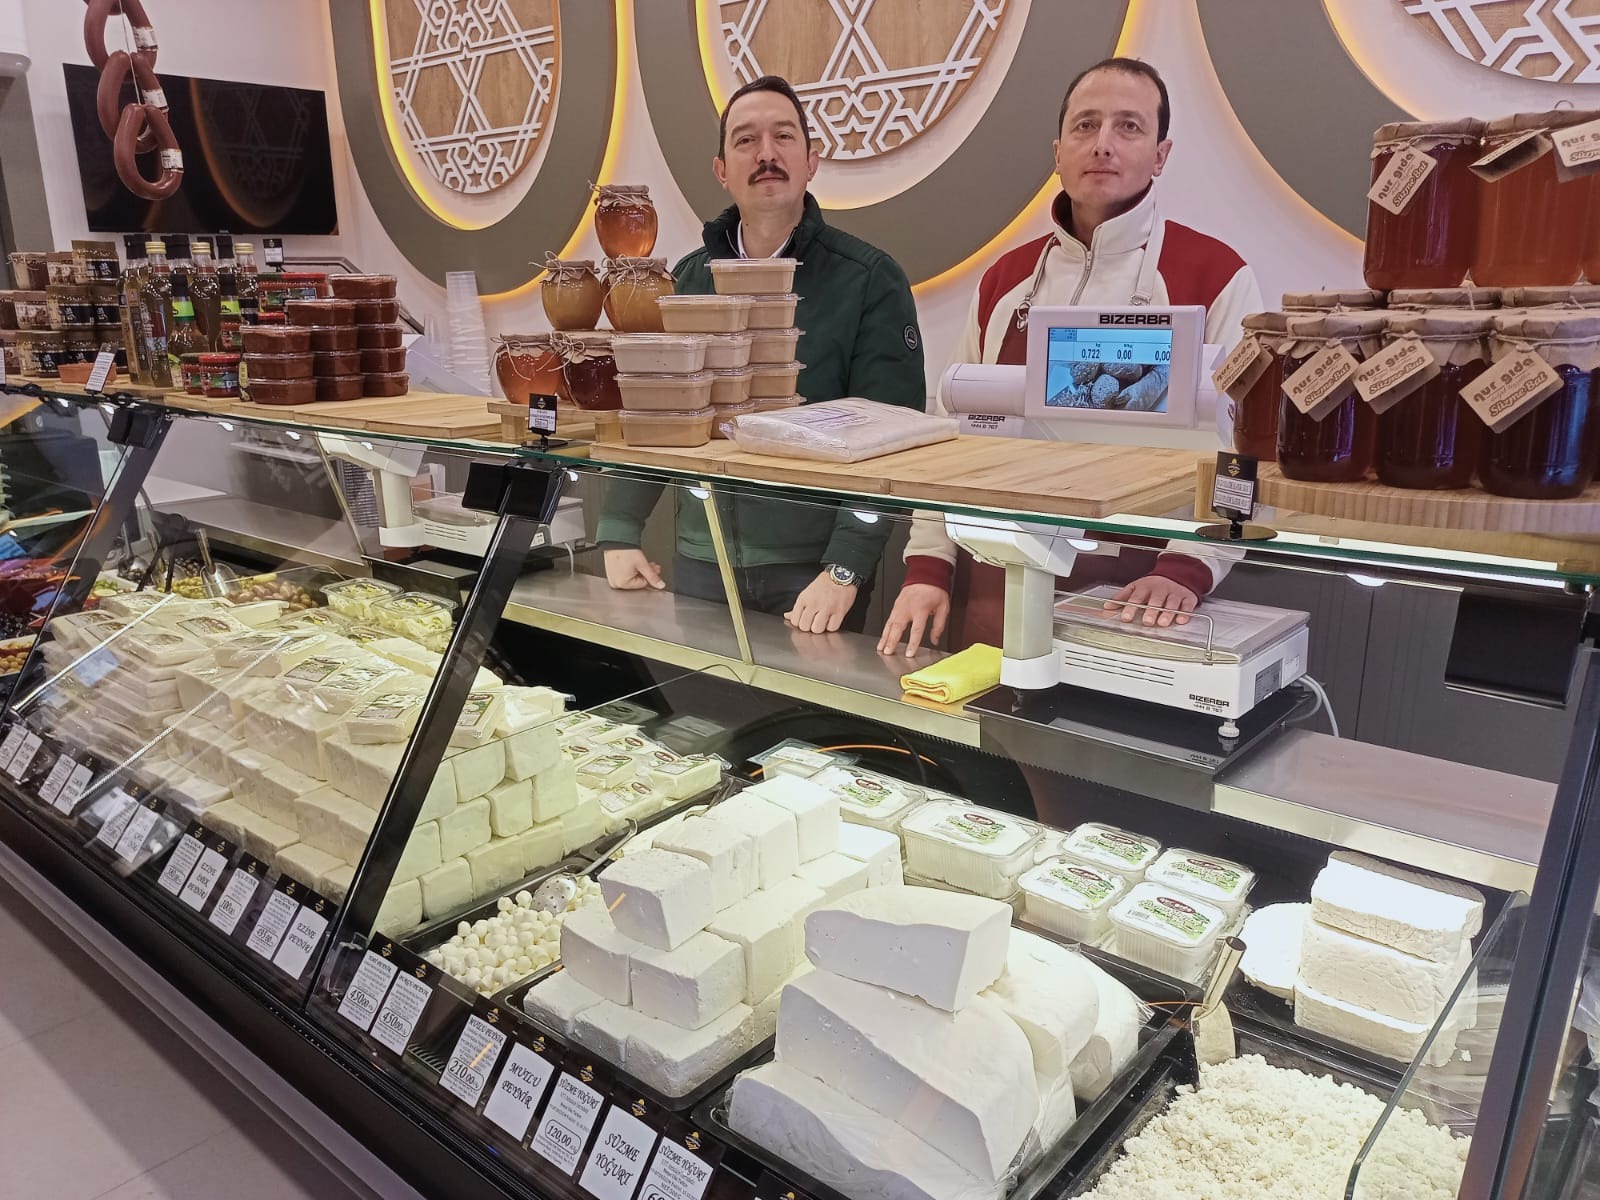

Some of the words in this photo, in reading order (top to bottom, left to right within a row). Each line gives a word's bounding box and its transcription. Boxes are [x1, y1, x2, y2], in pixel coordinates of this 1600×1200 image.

[1099, 314, 1171, 325] BIZERBA
[1081, 349, 1100, 360] 0,722
[1116, 349, 1132, 361] 0,00
[1154, 350, 1171, 362] 0,00
[1473, 381, 1497, 402] nur
[968, 414, 1006, 422] BIZERBA
[1189, 694, 1230, 707] BIZERBA
[509, 1062, 542, 1088] MUTLU
[502, 1080, 533, 1110] PEYNİR
[546, 1125, 572, 1147] 120,00
[604, 1132, 640, 1162] SÜZME
[595, 1152, 634, 1186] YOĞURT
[658, 1145, 682, 1166] SÜZME
[681, 1159, 708, 1182] YOĞURT
